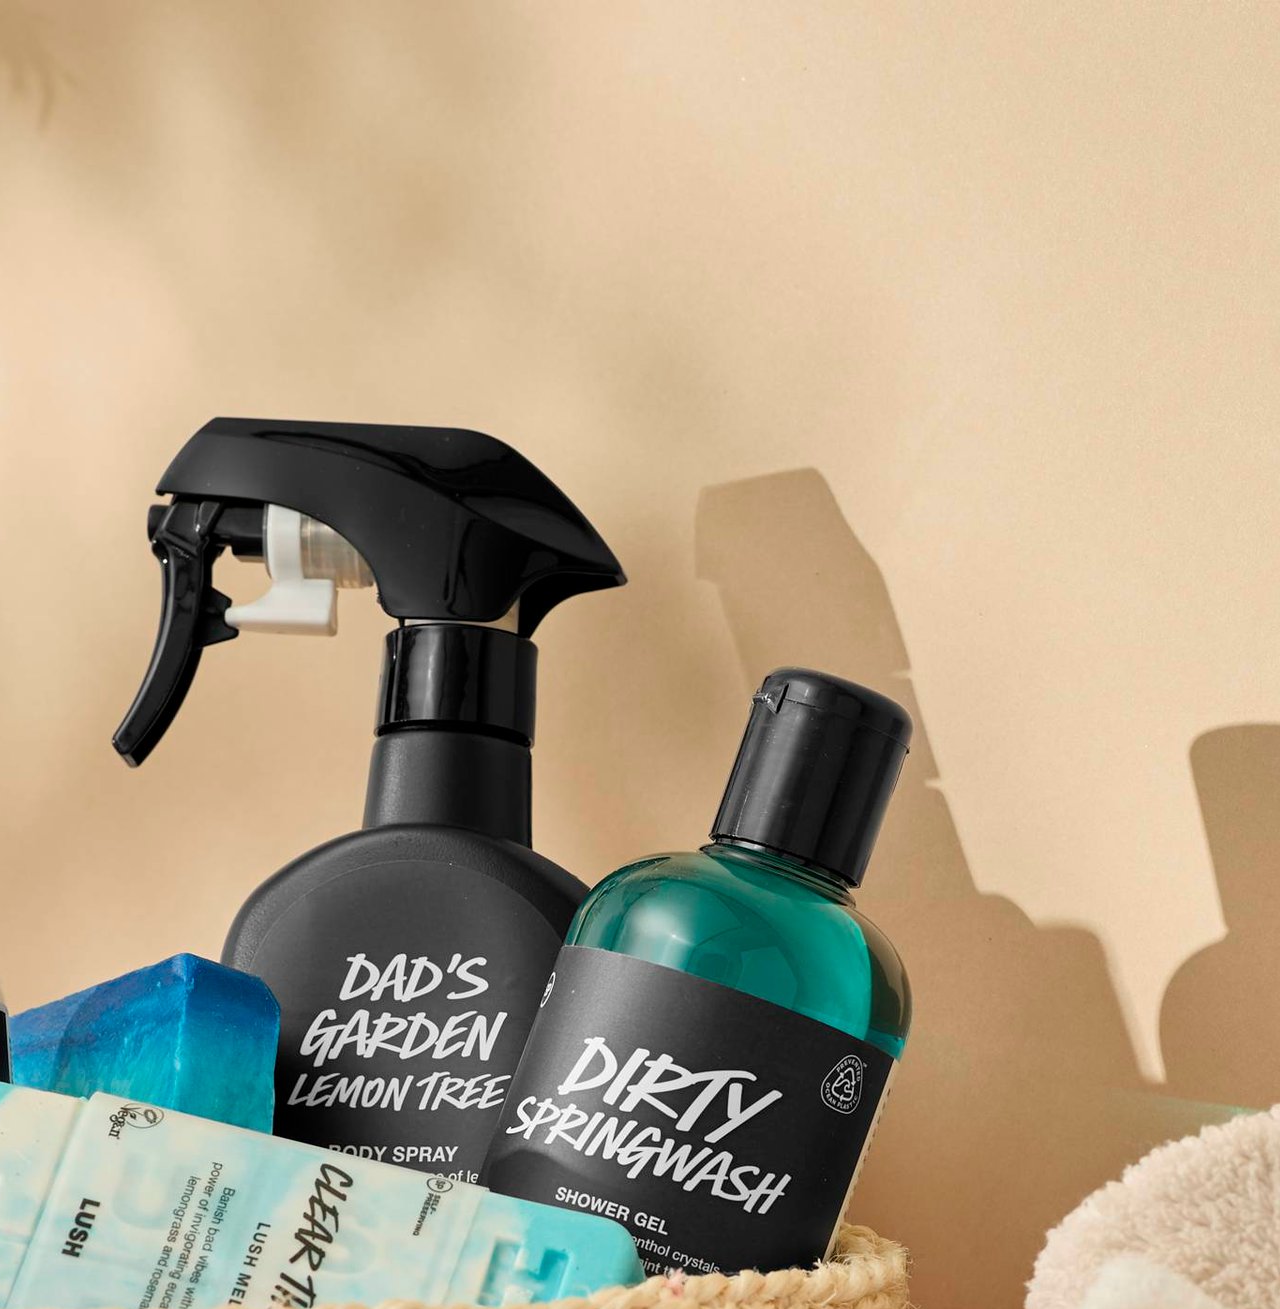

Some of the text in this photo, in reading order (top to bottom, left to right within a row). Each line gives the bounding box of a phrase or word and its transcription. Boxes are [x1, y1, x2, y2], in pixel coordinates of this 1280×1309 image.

[338, 952, 490, 1003] DAD'S
[299, 1008, 509, 1068] GARDEN
[286, 1071, 512, 1112] LEMON TREE
[558, 1036, 784, 1145] DIRTY
[392, 1145, 459, 1163] SPRAY
[505, 1095, 793, 1215] SPRINGWASH
[204, 1161, 223, 1198] power
[61, 1198, 100, 1259] LUSH
[167, 1174, 201, 1243] lemongrass
[199, 1198, 209, 1213] of
[211, 1186, 236, 1225] Banish
[289, 1163, 354, 1271] CLEAR
[555, 1186, 669, 1236] SHOWER GEL
[157, 1245, 173, 1268] and
[168, 1213, 204, 1281] invigorating
[202, 1227, 220, 1253] bad
[242, 1222, 271, 1268] LUSH
[672, 1250, 720, 1274] crystals
[190, 1254, 209, 1284] vibes
